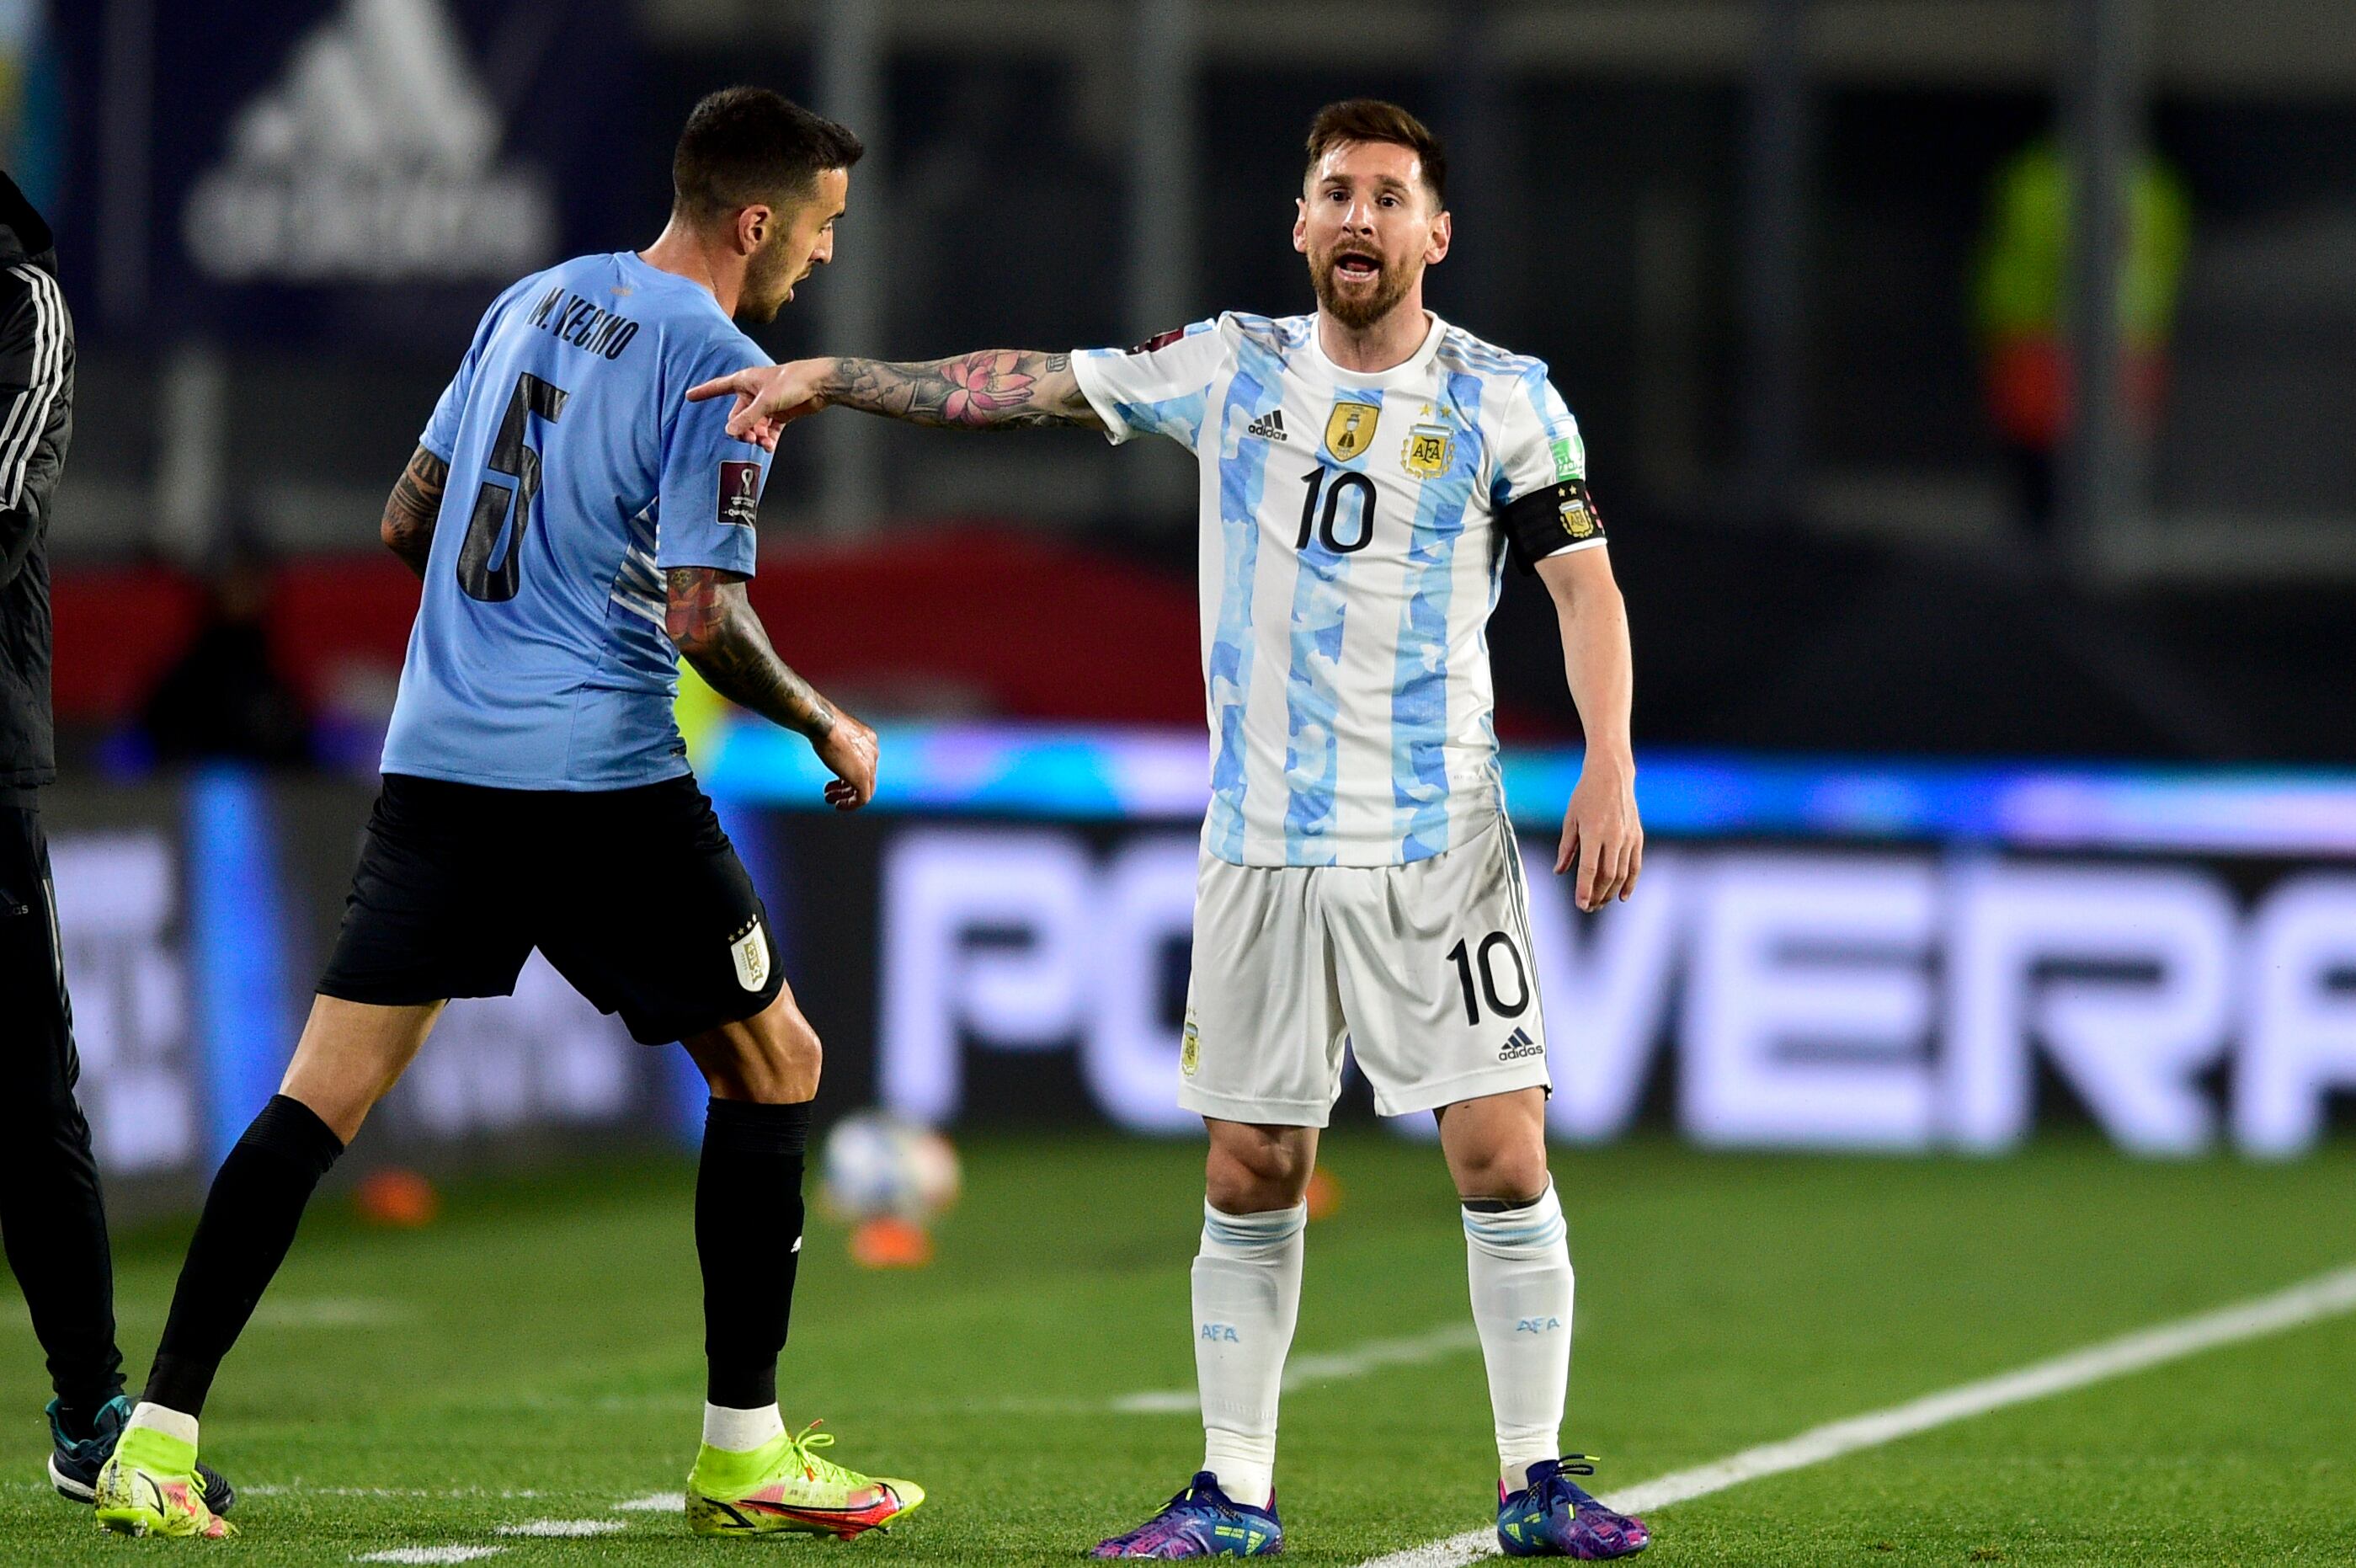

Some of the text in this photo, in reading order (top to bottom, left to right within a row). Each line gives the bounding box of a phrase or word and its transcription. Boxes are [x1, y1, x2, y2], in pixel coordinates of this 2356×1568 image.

[527, 286, 566, 330] M.
[1248, 424, 1288, 441] adidas
[1412, 436, 1441, 464] AFA
[456, 371, 570, 603] 5
[1294, 465, 1378, 555] 10
[1445, 931, 1530, 1027] 10
[1498, 1045, 1544, 1061] adidas
[1201, 1323, 1240, 1344] AFA
[1516, 1317, 1560, 1334] AFA
